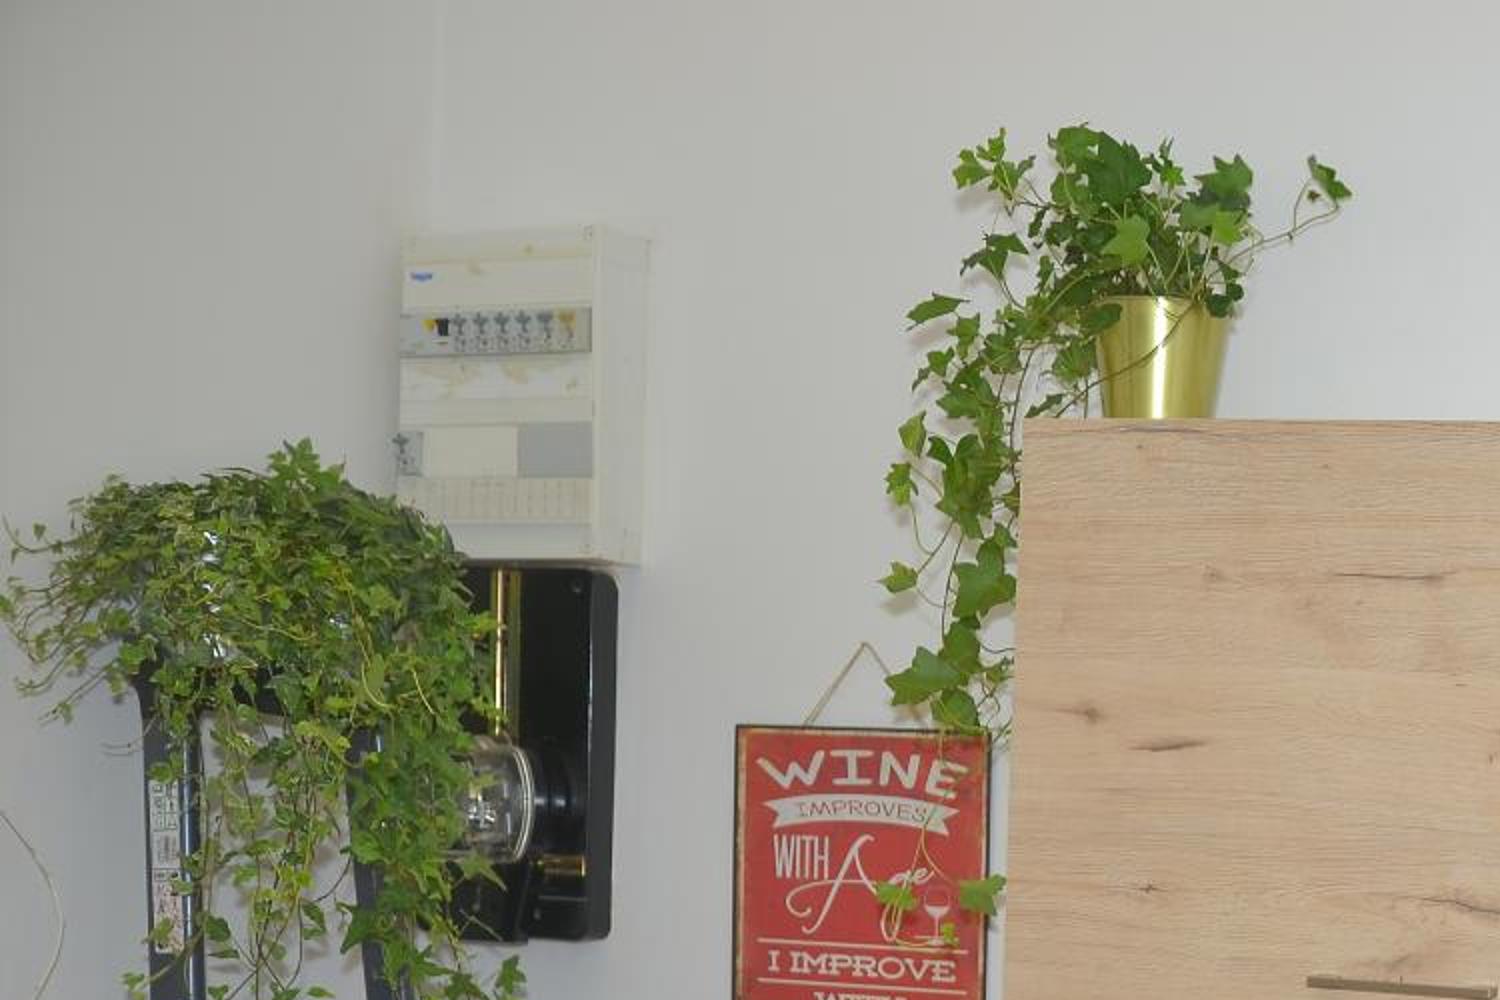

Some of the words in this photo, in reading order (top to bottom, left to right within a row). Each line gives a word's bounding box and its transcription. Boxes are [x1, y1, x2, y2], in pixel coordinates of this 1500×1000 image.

[756, 748, 969, 800] WINE
[798, 798, 928, 824] IMPROVES
[773, 833, 830, 881] WITH
[768, 949, 781, 973] I
[789, 950, 957, 984] IMPROVE
